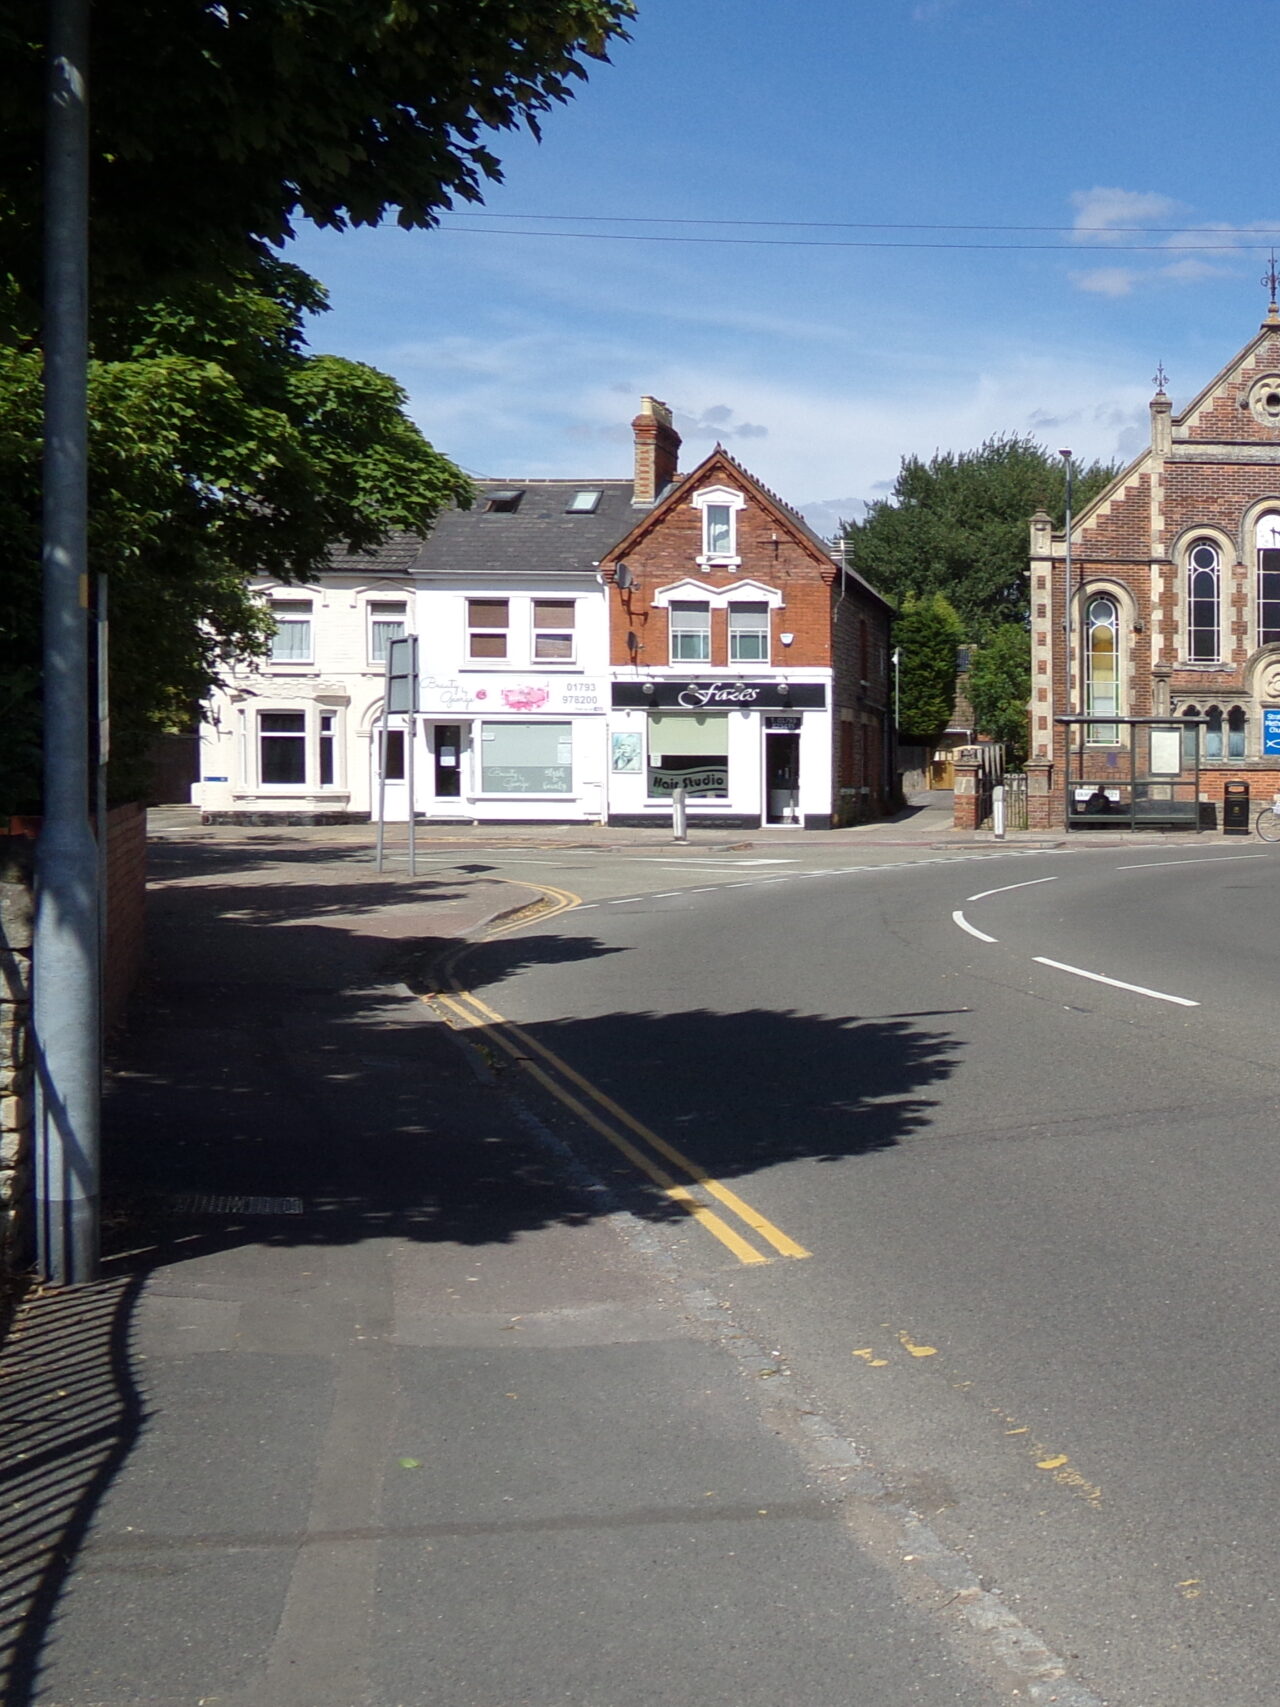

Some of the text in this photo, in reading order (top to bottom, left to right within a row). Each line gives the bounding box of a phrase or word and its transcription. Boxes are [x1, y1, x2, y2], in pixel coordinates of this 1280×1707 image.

[566, 683, 596, 692] 01793
[562, 695, 598, 705] 978200
[653, 774, 724, 790] Hair Studio
